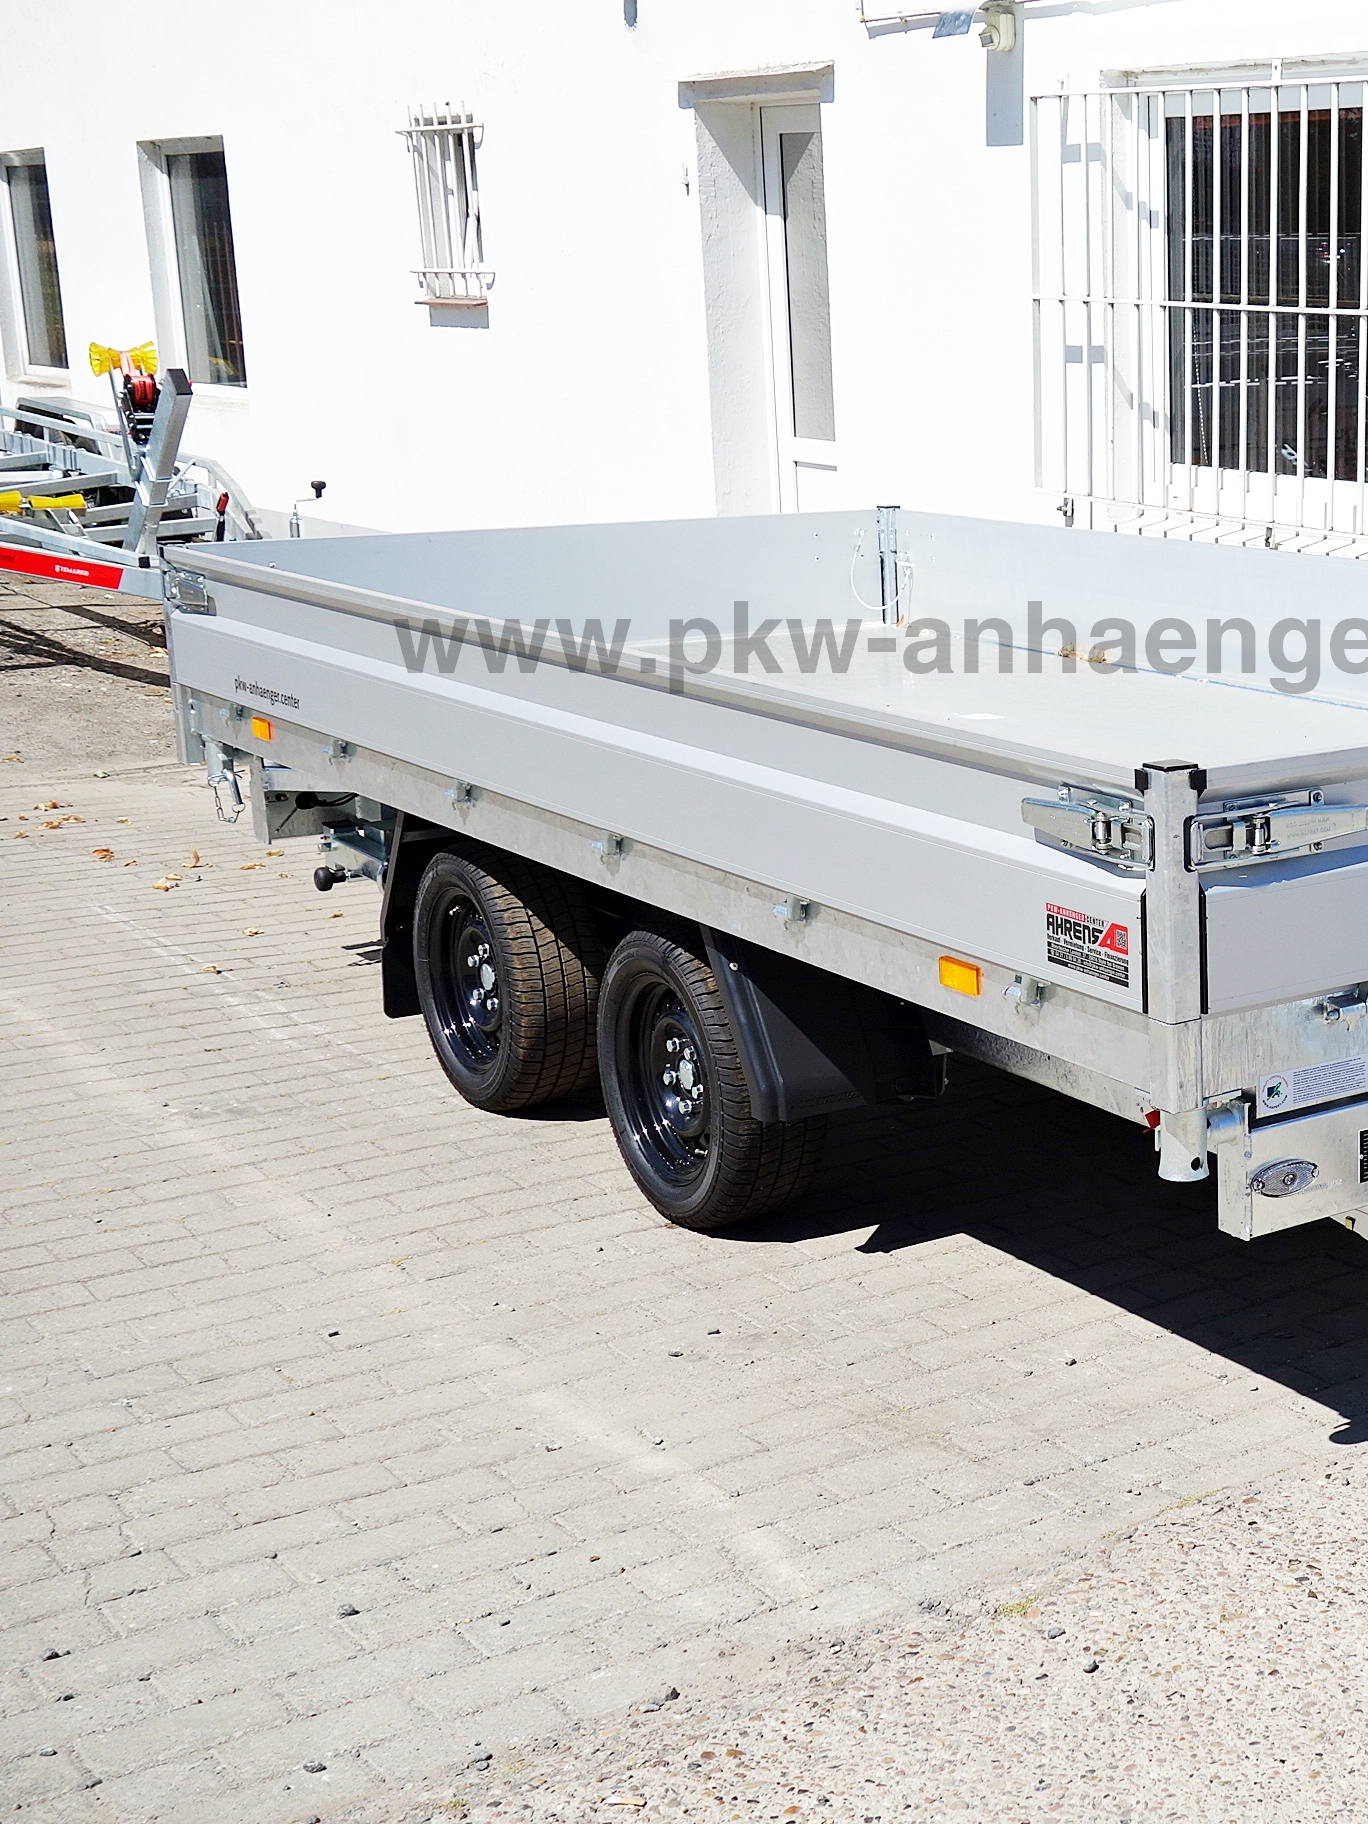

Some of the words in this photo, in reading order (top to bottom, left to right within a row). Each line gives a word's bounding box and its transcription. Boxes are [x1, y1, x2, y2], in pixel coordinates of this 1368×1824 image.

[234, 675, 300, 709] pkw-anhaenger.center
[1046, 913, 1104, 945] AHRENS
[1086, 915, 1105, 927] CENTER
